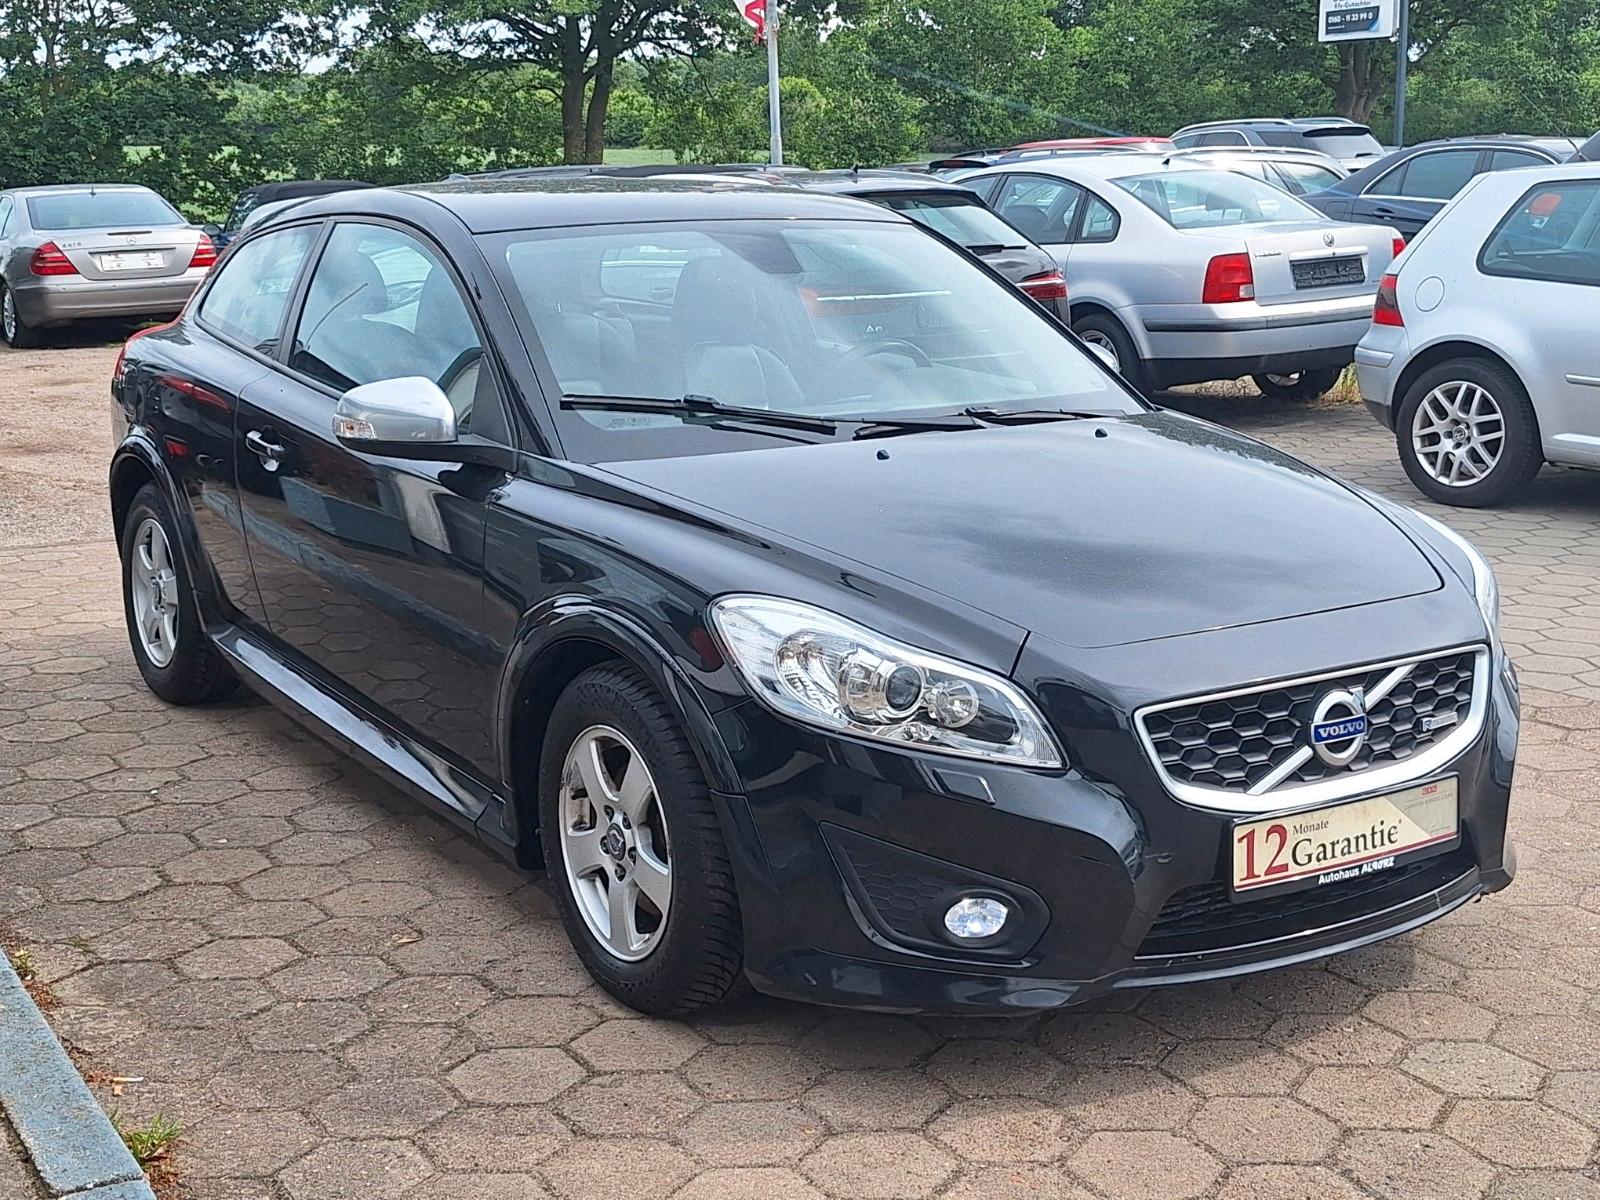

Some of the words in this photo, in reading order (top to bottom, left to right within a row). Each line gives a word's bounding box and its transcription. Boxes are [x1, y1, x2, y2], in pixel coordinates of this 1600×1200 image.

[1317, 720, 1364, 738] VOLVO
[1293, 819, 1329, 836] Monate
[1292, 820, 1399, 867] Garantie
[1237, 824, 1289, 882] 12
[1318, 867, 1360, 885] Autohaus
